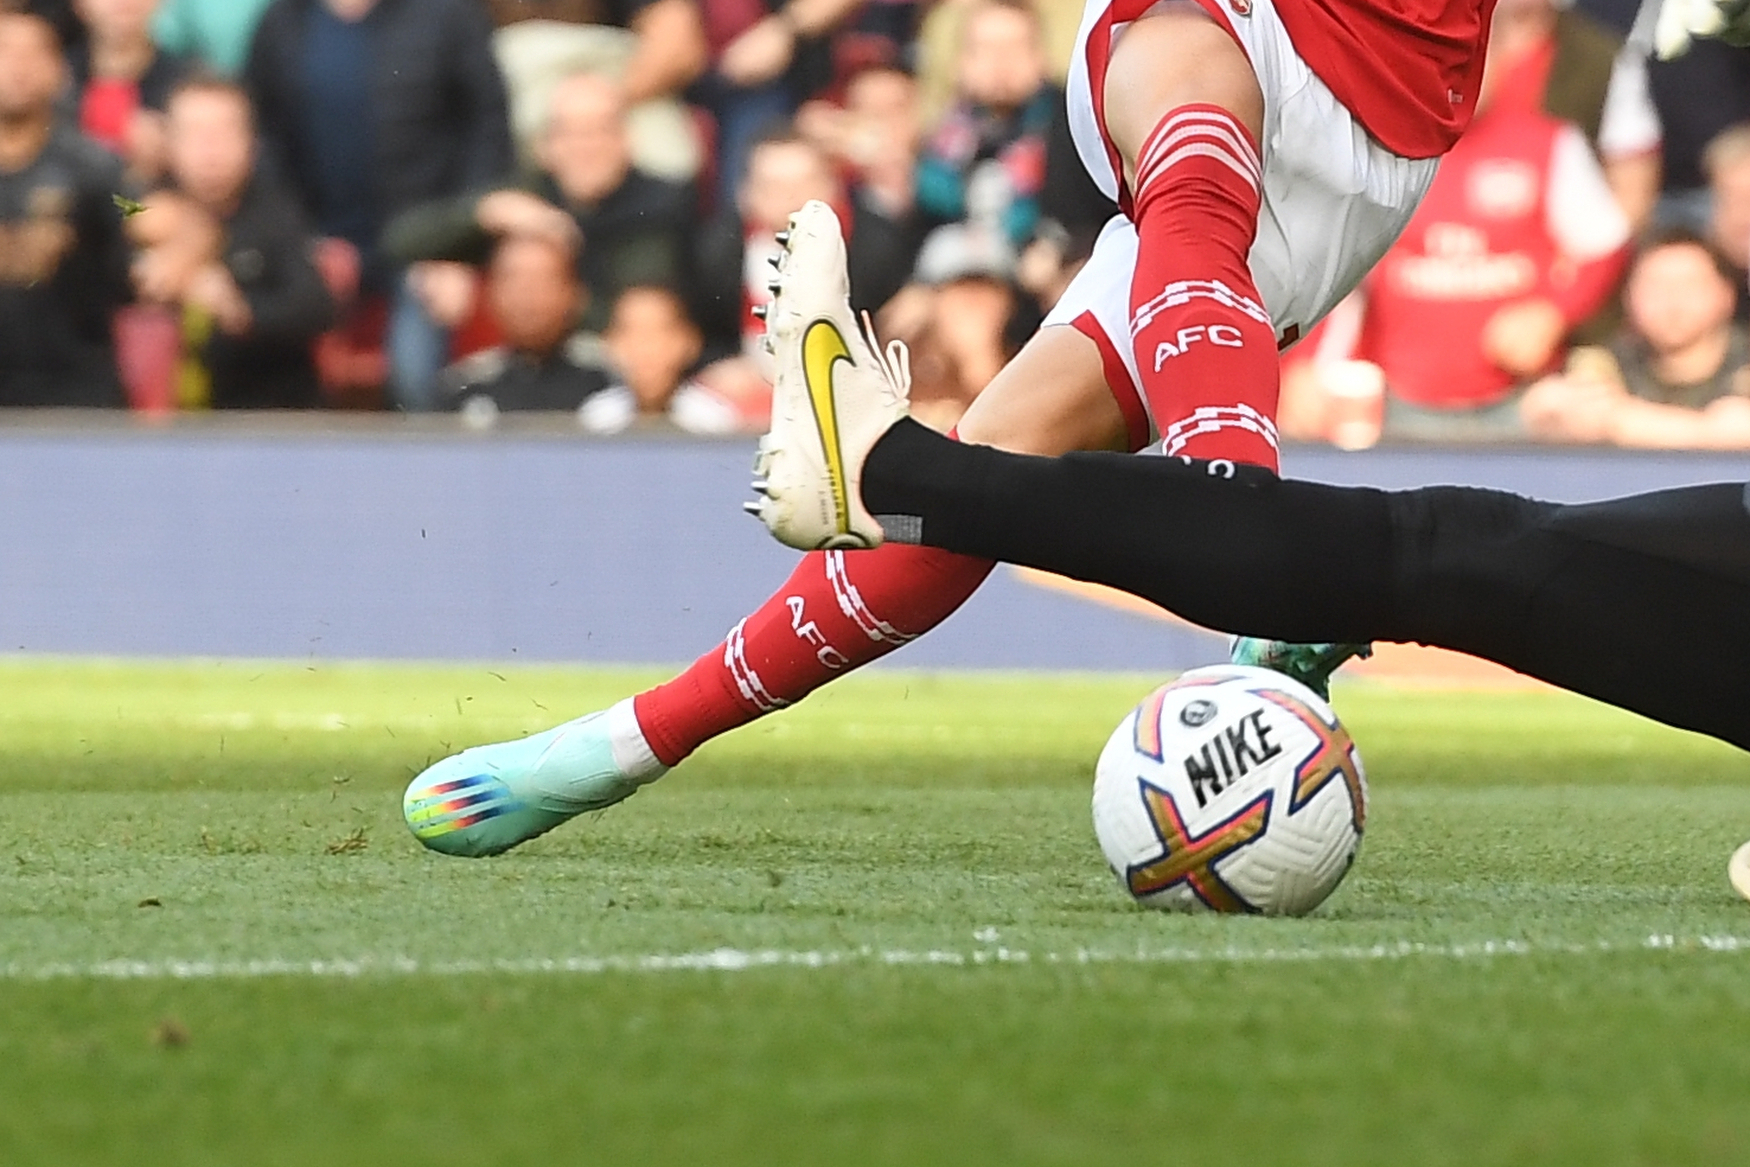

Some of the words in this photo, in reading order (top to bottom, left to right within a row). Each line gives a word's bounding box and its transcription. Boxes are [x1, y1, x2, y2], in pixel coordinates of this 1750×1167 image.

[1154, 324, 1244, 373] AFC
[785, 595, 849, 669] AFC
[1183, 707, 1283, 810] NIKE
